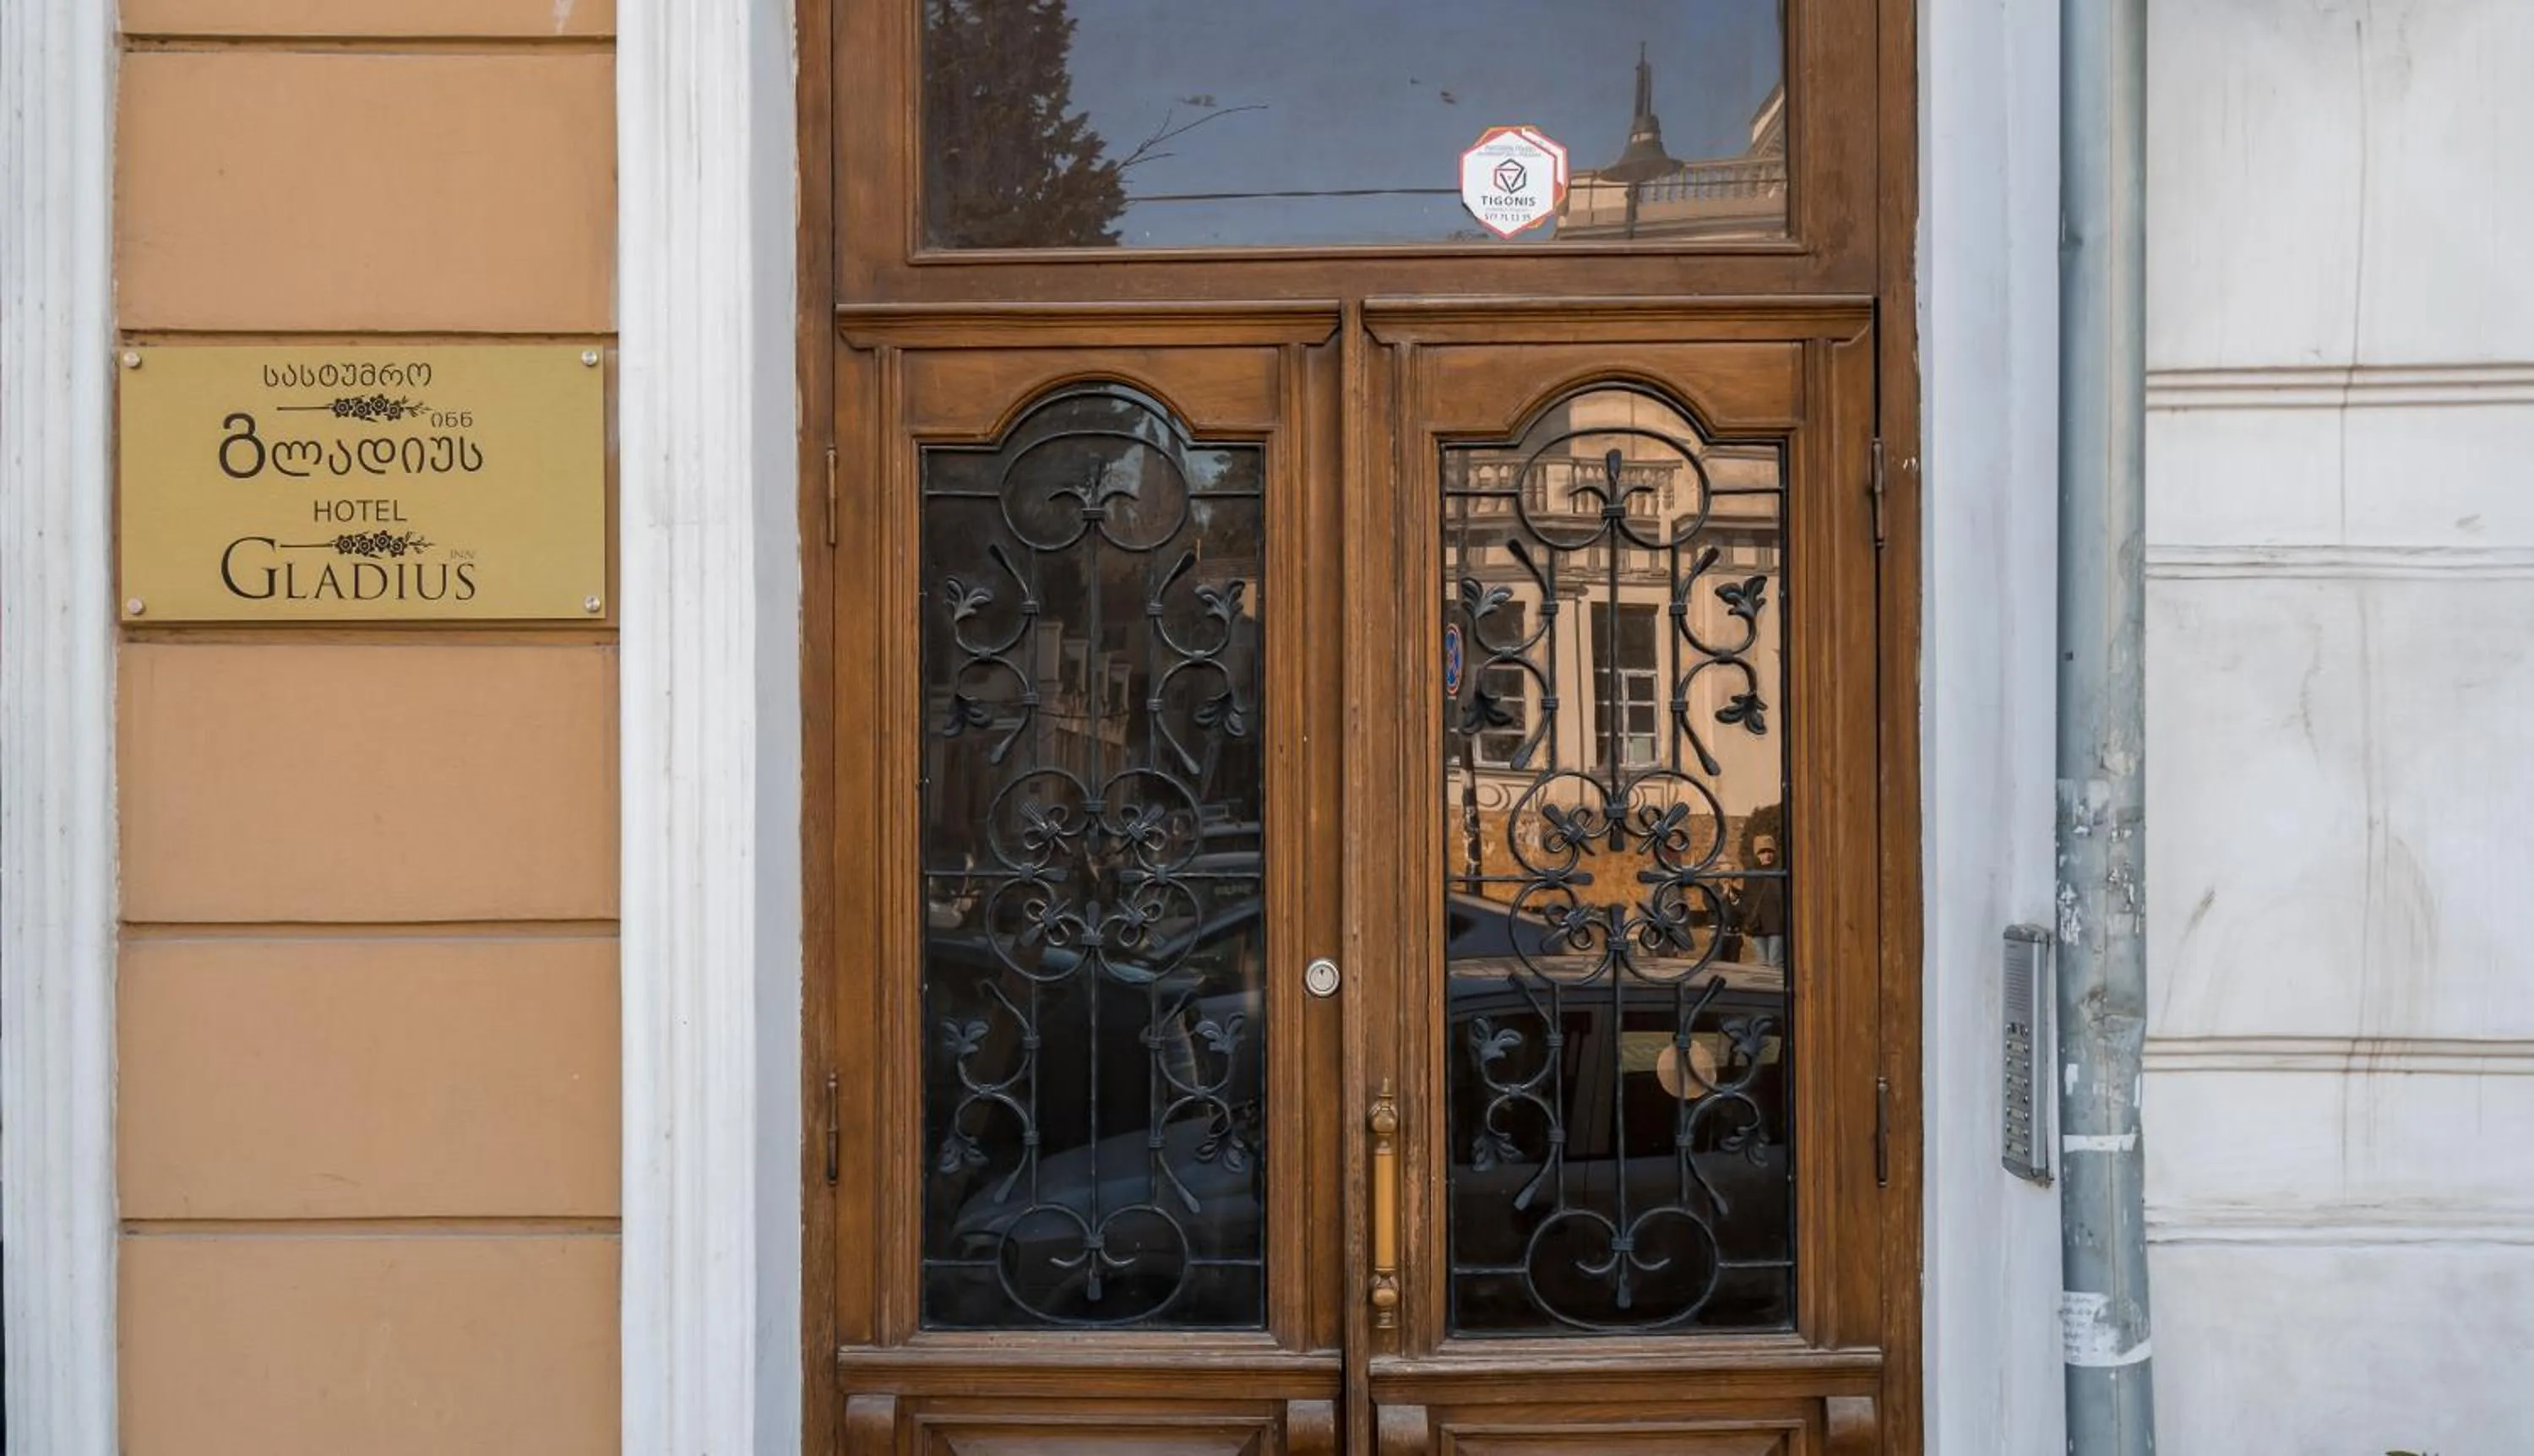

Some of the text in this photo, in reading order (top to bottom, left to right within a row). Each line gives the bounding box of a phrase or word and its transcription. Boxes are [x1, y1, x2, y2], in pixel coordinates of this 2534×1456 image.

[1481, 195, 1536, 207] TIGONIS
[263, 361, 432, 388] სასტუმრო
[218, 412, 484, 479] გლადიუს
[313, 499, 407, 522] HOTEL
